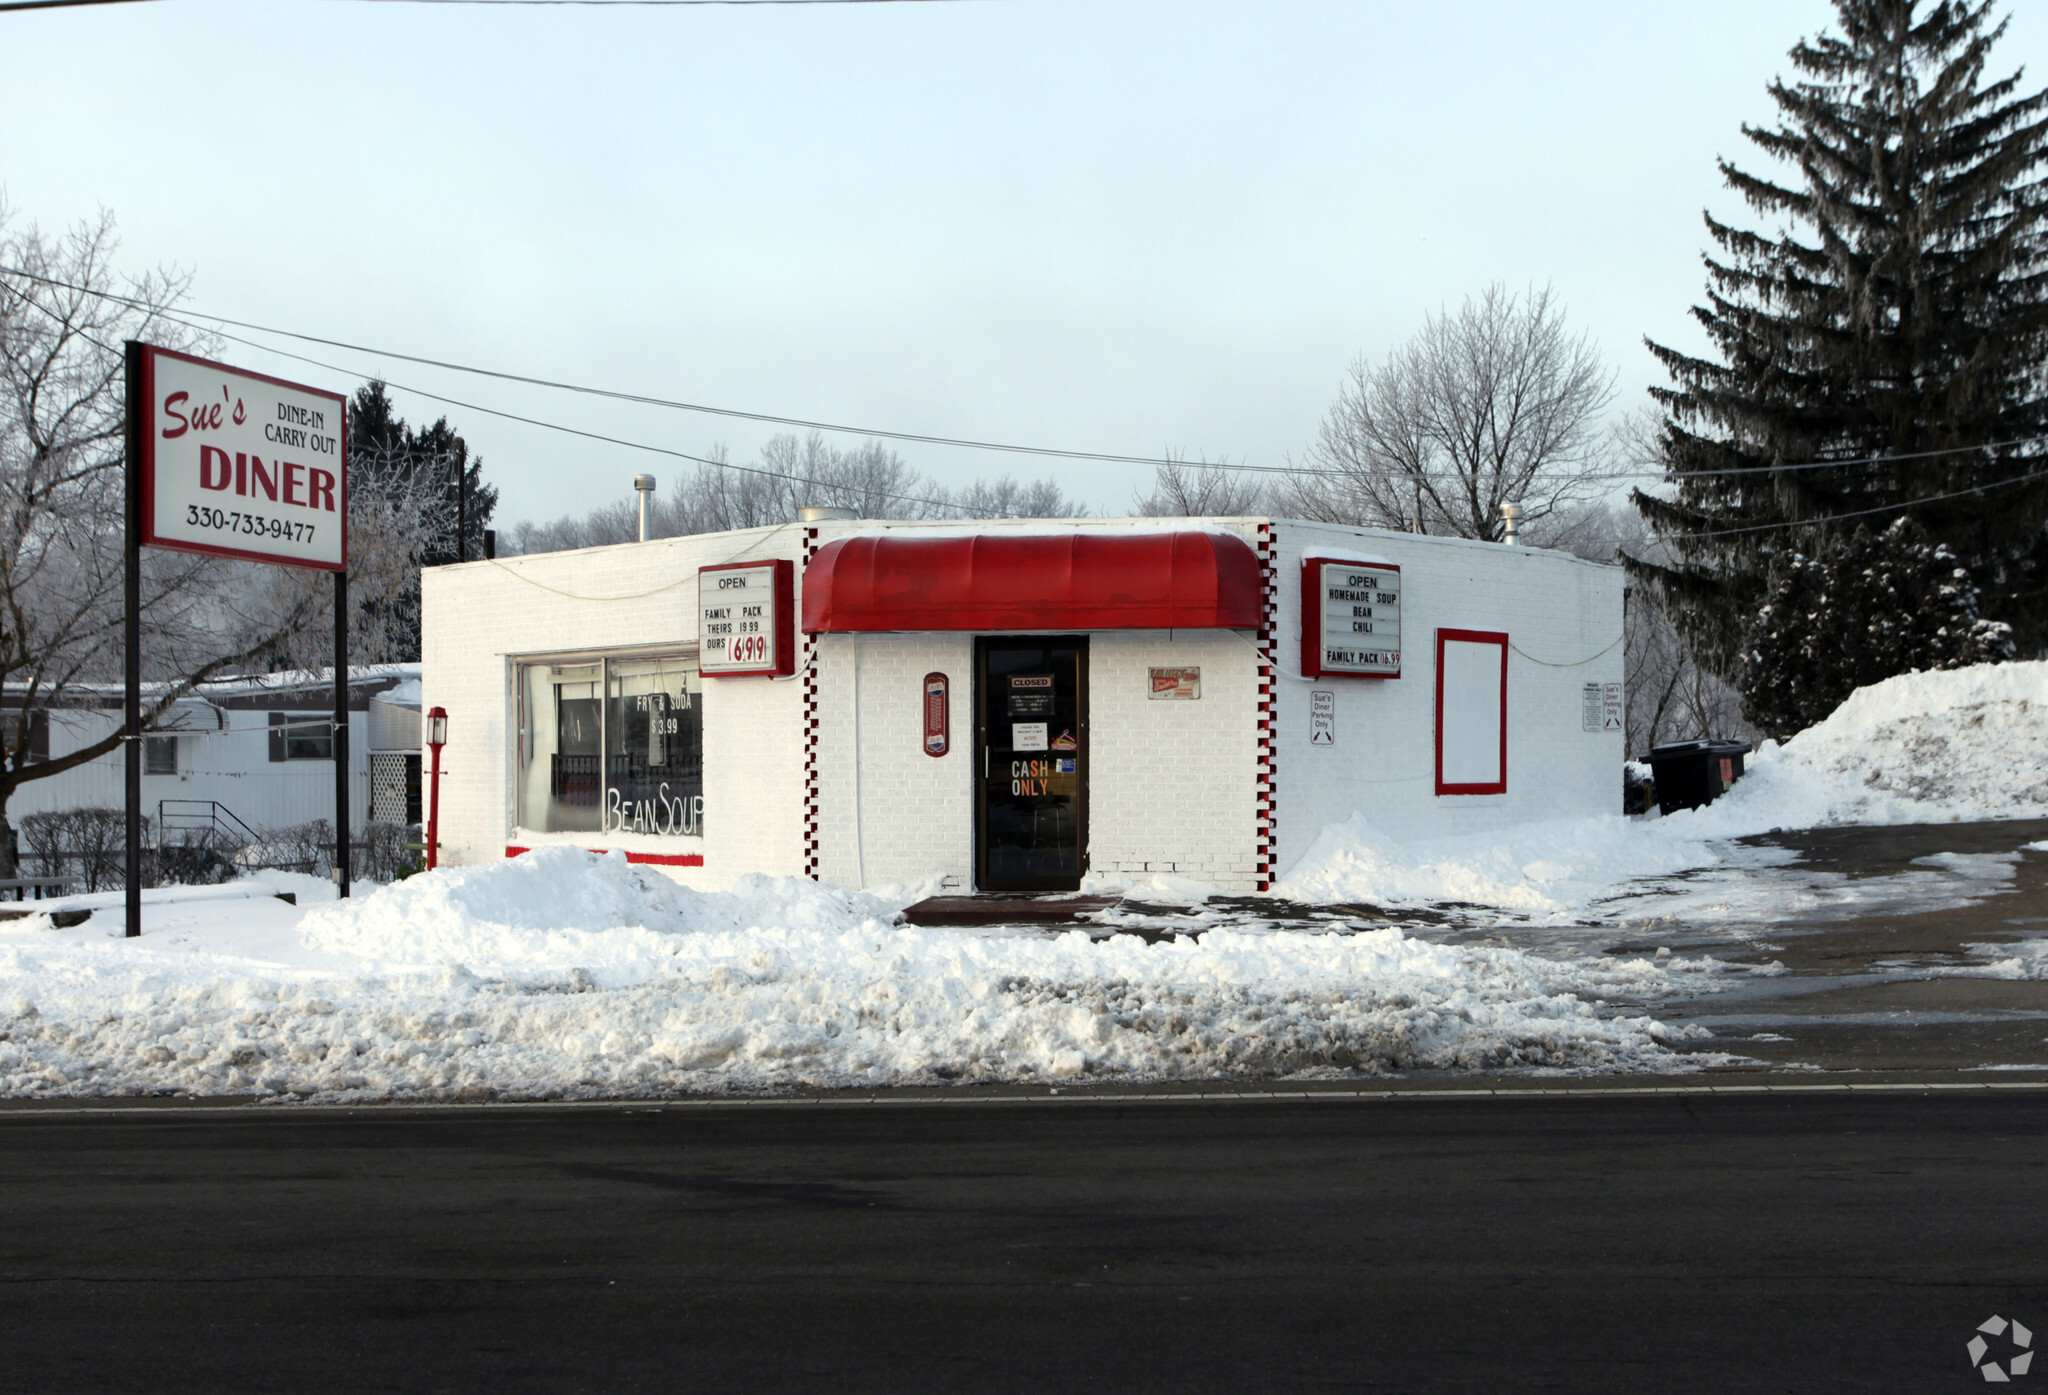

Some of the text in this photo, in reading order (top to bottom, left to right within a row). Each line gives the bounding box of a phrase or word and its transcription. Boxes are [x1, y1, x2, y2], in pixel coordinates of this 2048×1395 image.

[162, 385, 247, 439] Sue's
[277, 402, 325, 430] DINE-IN
[265, 423, 336, 455] CARRY OUT
[200, 444, 336, 513] DINER
[186, 504, 316, 544] 330-733-9477
[718, 577, 747, 590] OPEN
[1348, 575, 1378, 588] OPEN
[1329, 588, 1397, 605] HOMEMADE SOUP
[705, 605, 763, 620] FAMILY PACK
[1353, 606, 1372, 618] BEAN
[707, 622, 733, 635] THEIRS
[1353, 621, 1373, 633] CHILI
[706, 638, 727, 650] OURS
[1326, 650, 1356, 663] FAMILY
[1358, 652, 1379, 664] PACK
[636, 693, 691, 711] FRY & SODA
[1314, 693, 1331, 702] Sue's
[1314, 702, 1330, 710] Diner
[1606, 708, 1617, 716] Only
[1311, 711, 1333, 720] Parking
[1315, 720, 1328, 729] Only
[1011, 760, 1048, 778] CASH
[1011, 779, 1048, 796] ONLY
[605, 782, 704, 836] BEAN SOUP
